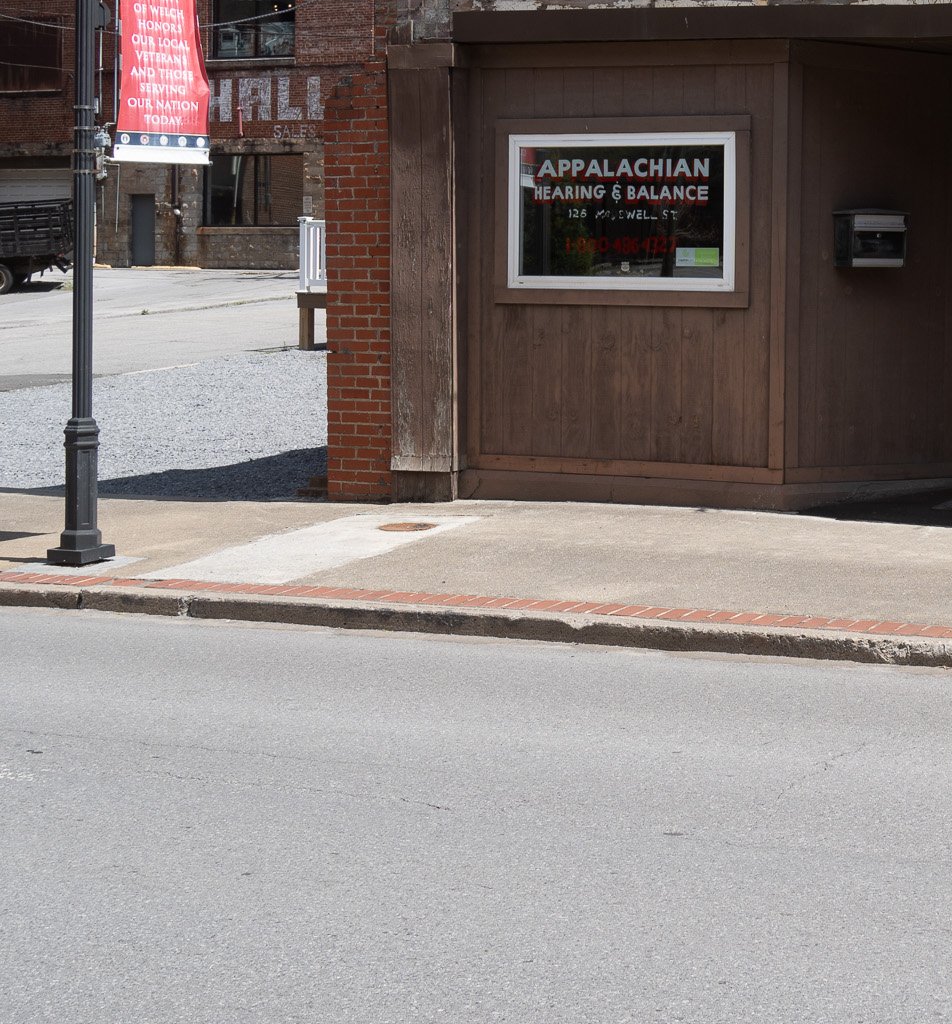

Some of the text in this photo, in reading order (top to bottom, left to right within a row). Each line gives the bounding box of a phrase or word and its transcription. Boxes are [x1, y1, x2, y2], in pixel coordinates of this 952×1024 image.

[133, 3, 184, 19] OF WELCH
[138, 19, 182, 33] HONORS
[132, 34, 190, 50] OUR LOCAL
[135, 50, 187, 65] VETERANS
[130, 66, 194, 81] AND THOSE
[140, 83, 186, 95] SERVING
[127, 97, 199, 111] OUR NATION
[144, 114, 184, 126] TODAY.
[274, 125, 316, 138] SALES
[537, 158, 710, 177] APPALACHIAN
[534, 181, 709, 203] HEARING & BALANCE
